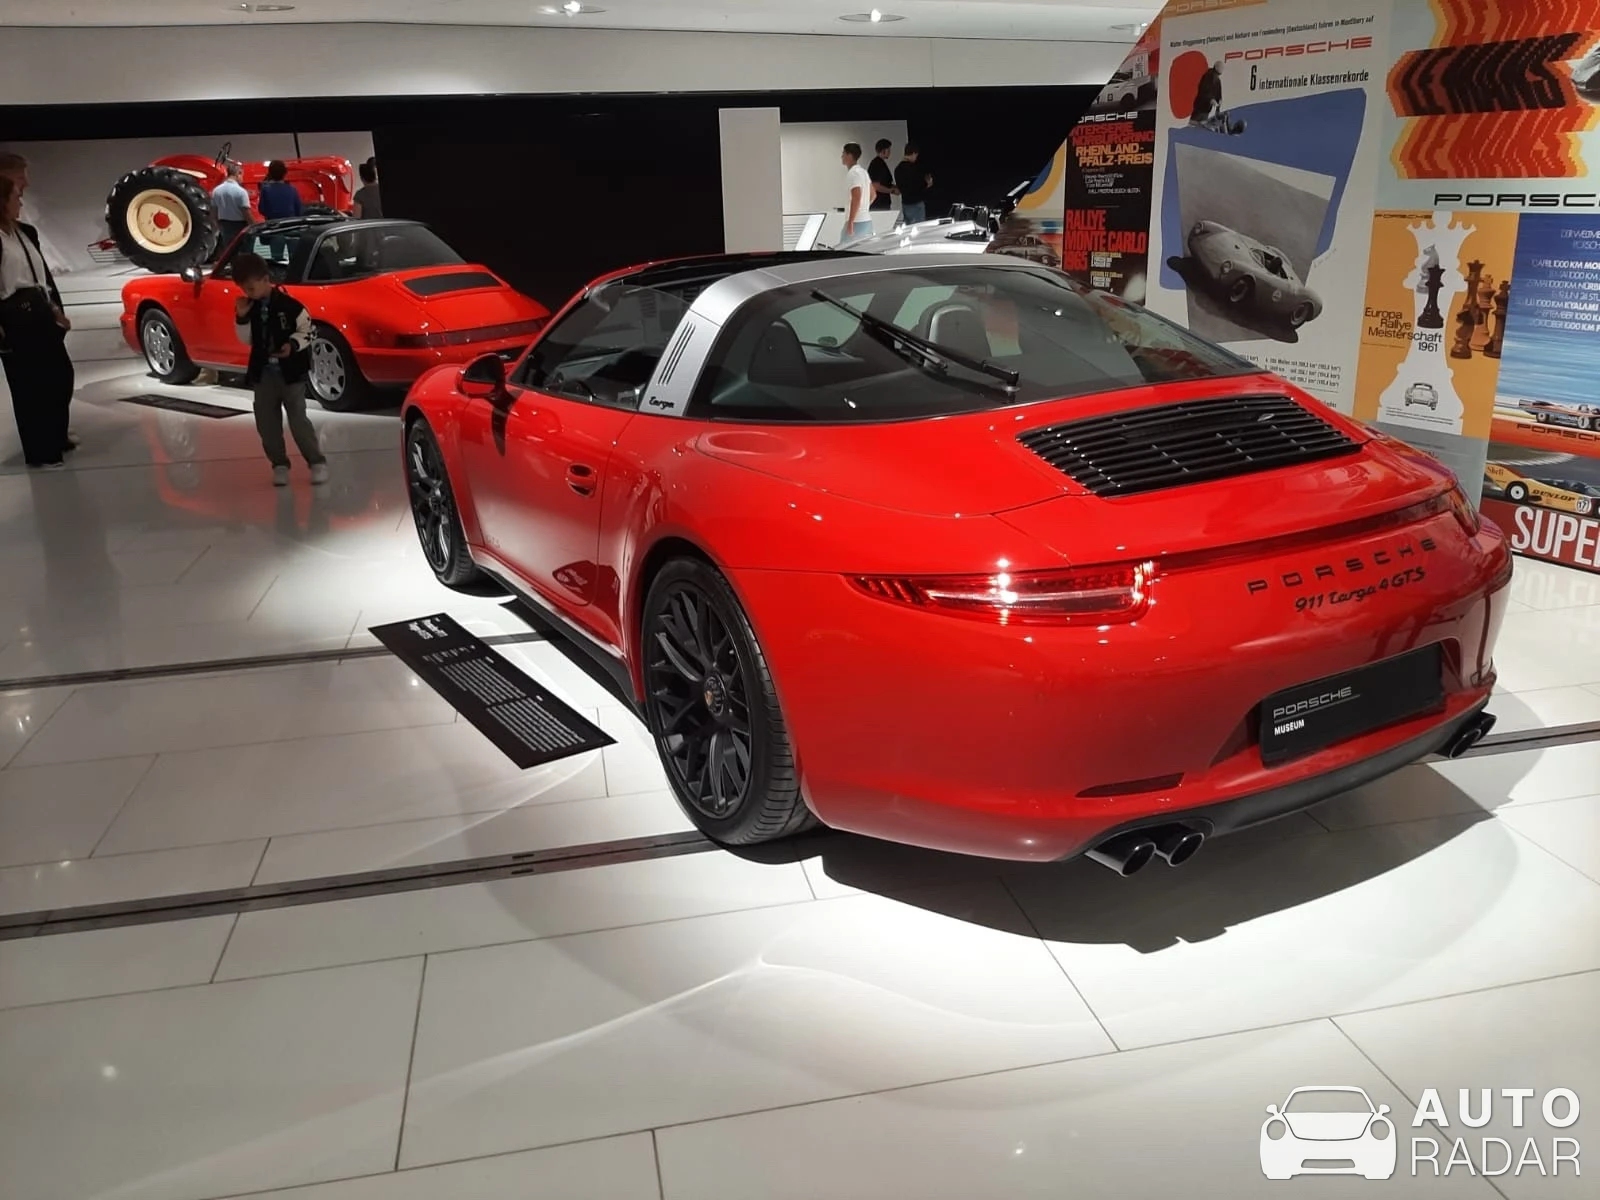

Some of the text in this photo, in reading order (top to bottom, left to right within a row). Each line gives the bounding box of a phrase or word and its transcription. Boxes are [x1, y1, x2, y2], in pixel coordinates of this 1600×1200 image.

[1225, 36, 1373, 63] PORSCHE
[1250, 65, 1370, 91] 6 internationale Klassenrekorde
[1079, 153, 1154, 167] PFALZ-PREIS
[1434, 193, 1600, 207] PORSC
[1066, 209, 1107, 231] RALLYE
[1064, 230, 1147, 254] MONTE CARLO
[1062, 250, 1088, 271] 1965
[1564, 301, 1599, 311] KYALAMI
[1364, 307, 1403, 323] Europa
[1575, 312, 1592, 321] 1000
[1380, 317, 1412, 333] Rallye
[1582, 323, 1595, 331] KM
[1368, 327, 1442, 344] Meisterschaft
[1418, 341, 1438, 353] 1961
[1532, 489, 1576, 502] DUNLOP
[1511, 505, 1600, 568] SUPE
[1246, 537, 1437, 595] PORSCHE
[1294, 566, 1427, 612] 911 Targa 4 GTS
[1272, 687, 1353, 719] PORSCHE
[1274, 720, 1305, 736] MUSEUM
